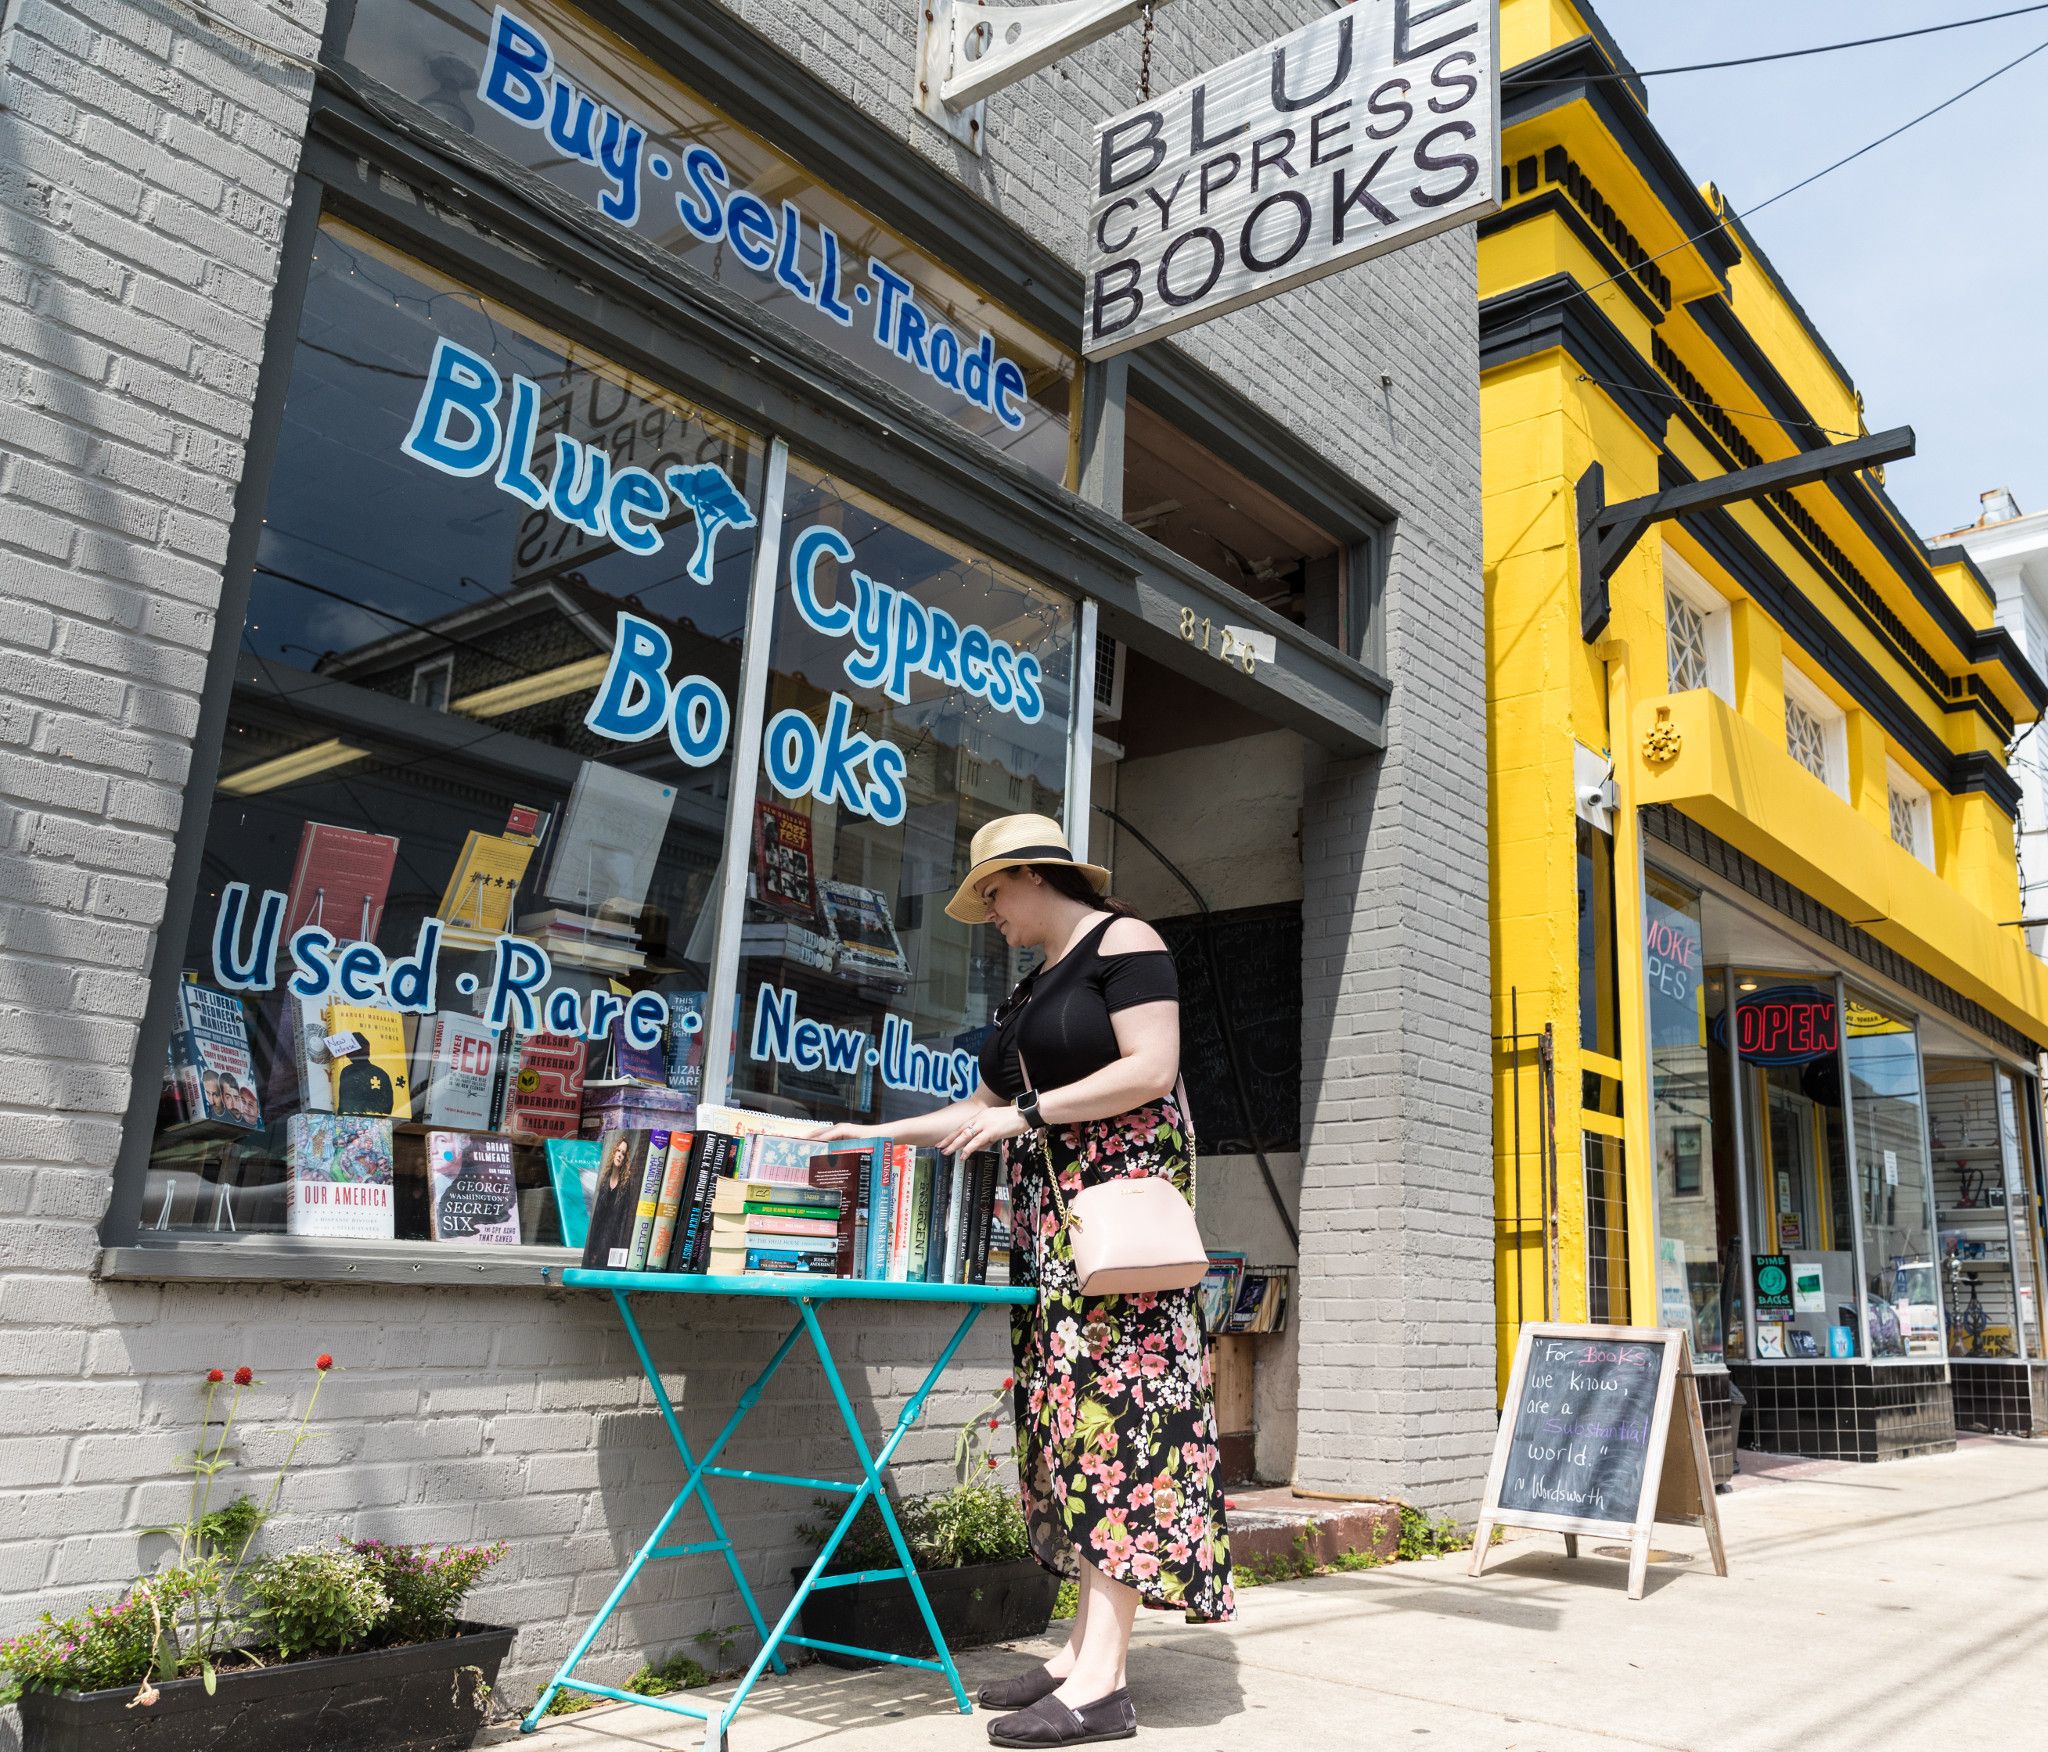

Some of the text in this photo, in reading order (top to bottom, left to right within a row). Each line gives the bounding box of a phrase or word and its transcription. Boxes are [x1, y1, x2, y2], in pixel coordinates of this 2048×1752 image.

[1100, 0, 1479, 197] BLUE
[478, 5, 648, 227] Buy
[1096, 50, 1478, 254] CYPRESS
[1093, 120, 1479, 339] BOOKS
[779, 819, 808, 837] JAZZ
[780, 829, 807, 848] FEST
[212, 881, 446, 1014] Used
[483, 934, 670, 1051] Rare
[194, 989, 238, 1013] THE LIBERAL
[200, 1015, 241, 1037] MANIFESTO
[201, 1004, 236, 1024] REDNECK
[341, 1012, 398, 1024] HARUKI MURAKAMI
[434, 1021, 445, 1047] LOWER
[672, 1030, 692, 1038] IGHT
[1735, 1003, 1838, 1052] OPEN
[450, 1034, 463, 1071] LOWER
[535, 1034, 570, 1048] COLSON
[750, 982, 866, 1075] New
[880, 1013, 979, 1101] Unus
[461, 1036, 492, 1077] ED
[523, 1055, 575, 1071] HITEHEAD
[669, 1065, 701, 1075] LIZA
[504, 1088, 516, 1127] ACCUSATION
[516, 1095, 577, 1111] NDERGROUND
[522, 1117, 565, 1131] RAILROAD
[473, 1151, 511, 1163] KILMEADE
[485, 1142, 509, 1153] BRIAN
[702, 1133, 717, 1161] LAURELL
[712, 1138, 728, 1171] LAURELL
[654, 1156, 664, 1188] LAURELL
[882, 1141, 892, 1186] PAUL LINDSAY
[456, 1180, 511, 1194] GEORGE
[644, 1157, 658, 1195] HAMILTON
[694, 1169, 709, 1202] HAMILTON
[858, 1164, 869, 1205] MUTINY
[980, 1154, 997, 1204] ABUNDANCE
[304, 1185, 387, 1208] OUR AMERICA
[444, 1201, 504, 1216] SECRET
[449, 1192, 509, 1202] WASHINGTON'S
[701, 1183, 717, 1224] HAMILTON
[443, 1215, 475, 1232] SIX
[688, 1212, 699, 1229] LICK
[914, 1182, 930, 1259] INSURGENT
[961, 1212, 969, 1241] CAITLIN
[479, 1234, 513, 1243] THAT SAVED
[636, 1222, 649, 1260] BULLET
[687, 1229, 696, 1238] OF
[682, 1239, 695, 1260] FROST
[875, 1234, 887, 1269] RESERVE
[1757, 1257, 1786, 1266] DIME
[1758, 1295, 1790, 1305] BAGS
[1531, 1373, 1553, 1389] we
[1527, 1398, 1574, 1415] are a
[1542, 1415, 1650, 1449] Substantial
[1532, 1473, 1605, 1511] Wordsworth
